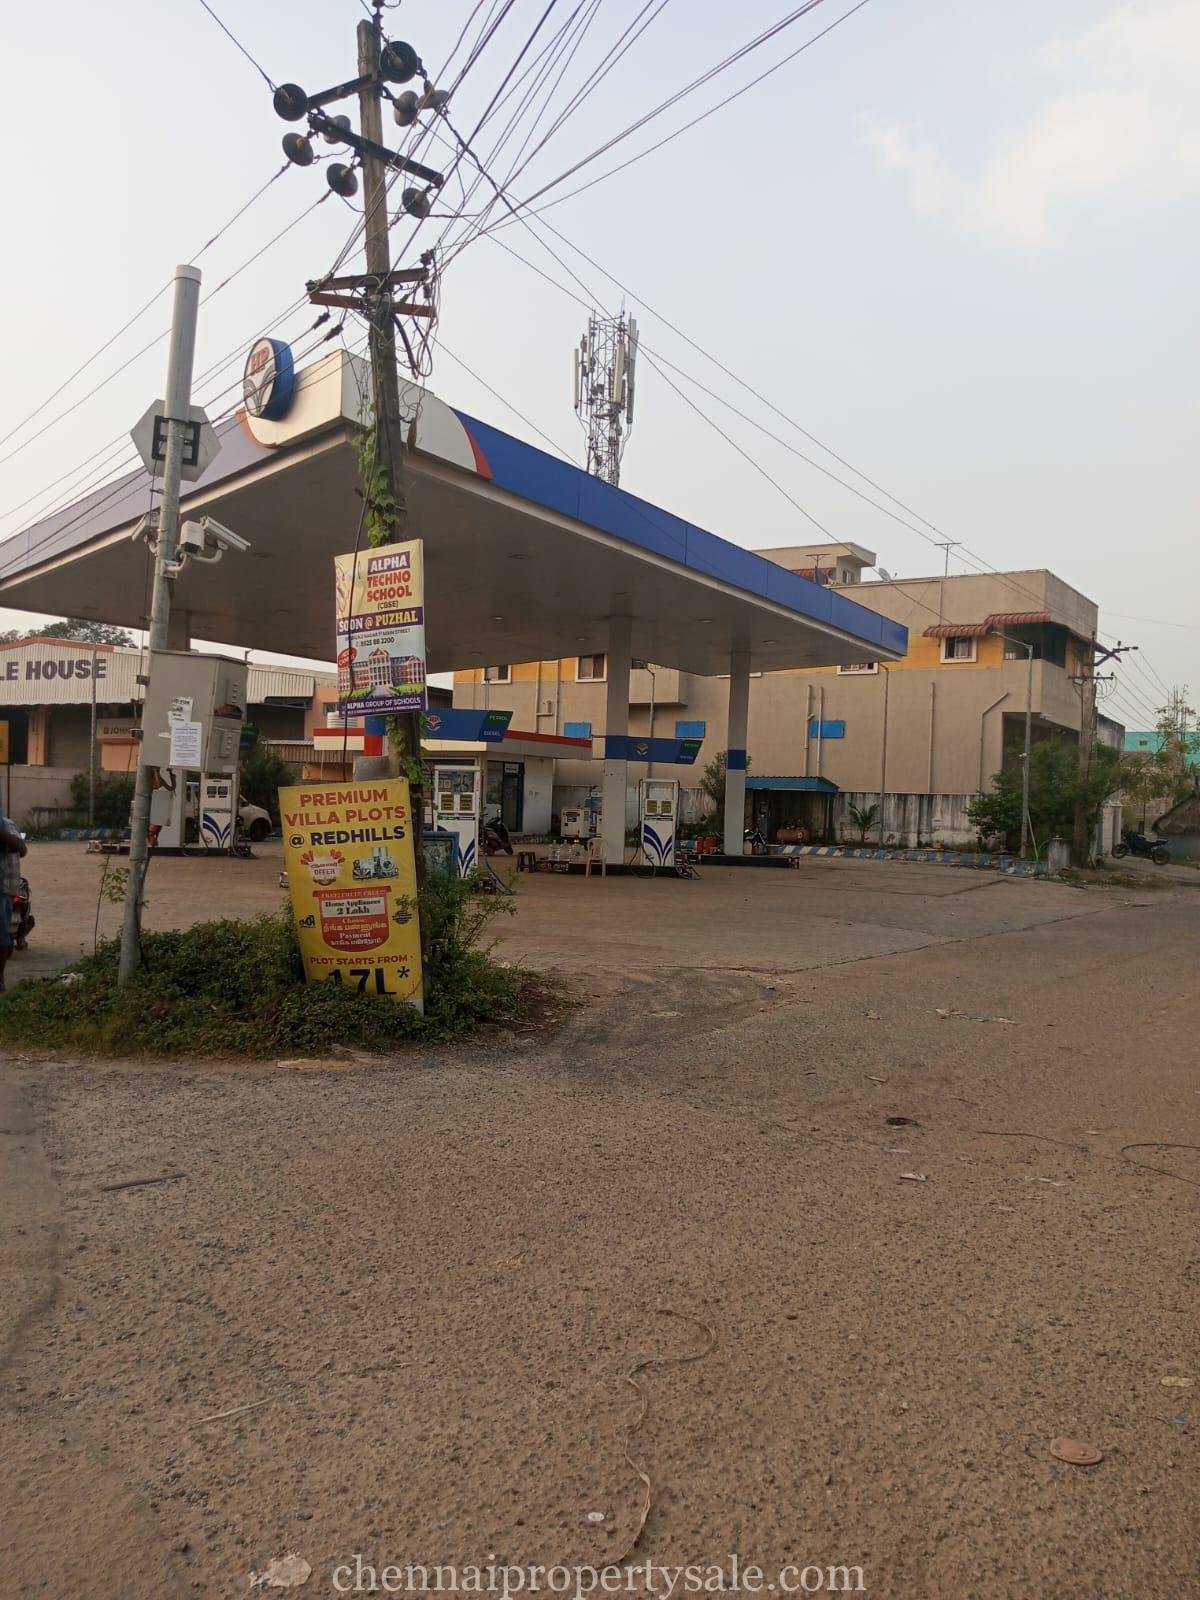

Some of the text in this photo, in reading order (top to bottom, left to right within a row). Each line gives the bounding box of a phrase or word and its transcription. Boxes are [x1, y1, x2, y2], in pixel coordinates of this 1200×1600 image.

[251, 347, 270, 376] HP
[370, 555, 407, 572] ALPHA
[367, 571, 411, 588] TECHNO
[367, 585, 412, 602] SCHOOL
[339, 610, 418, 632] SOON @ PUZHAL
[0, 659, 107, 681] E HOUSE
[347, 702, 365, 710] ALPHA
[365, 700, 384, 708] GROUP
[394, 697, 421, 705] SCHOOLS
[299, 788, 389, 807] PREMIUM
[284, 805, 406, 827] VILLA PLOTS
[289, 825, 406, 849] @ REDHILLS
[336, 906, 370, 915] 2 Lakh
[347, 899, 381, 908] Appliances
[339, 932, 371, 940] Payment
[310, 954, 408, 966] PLOT STARTS FROM
